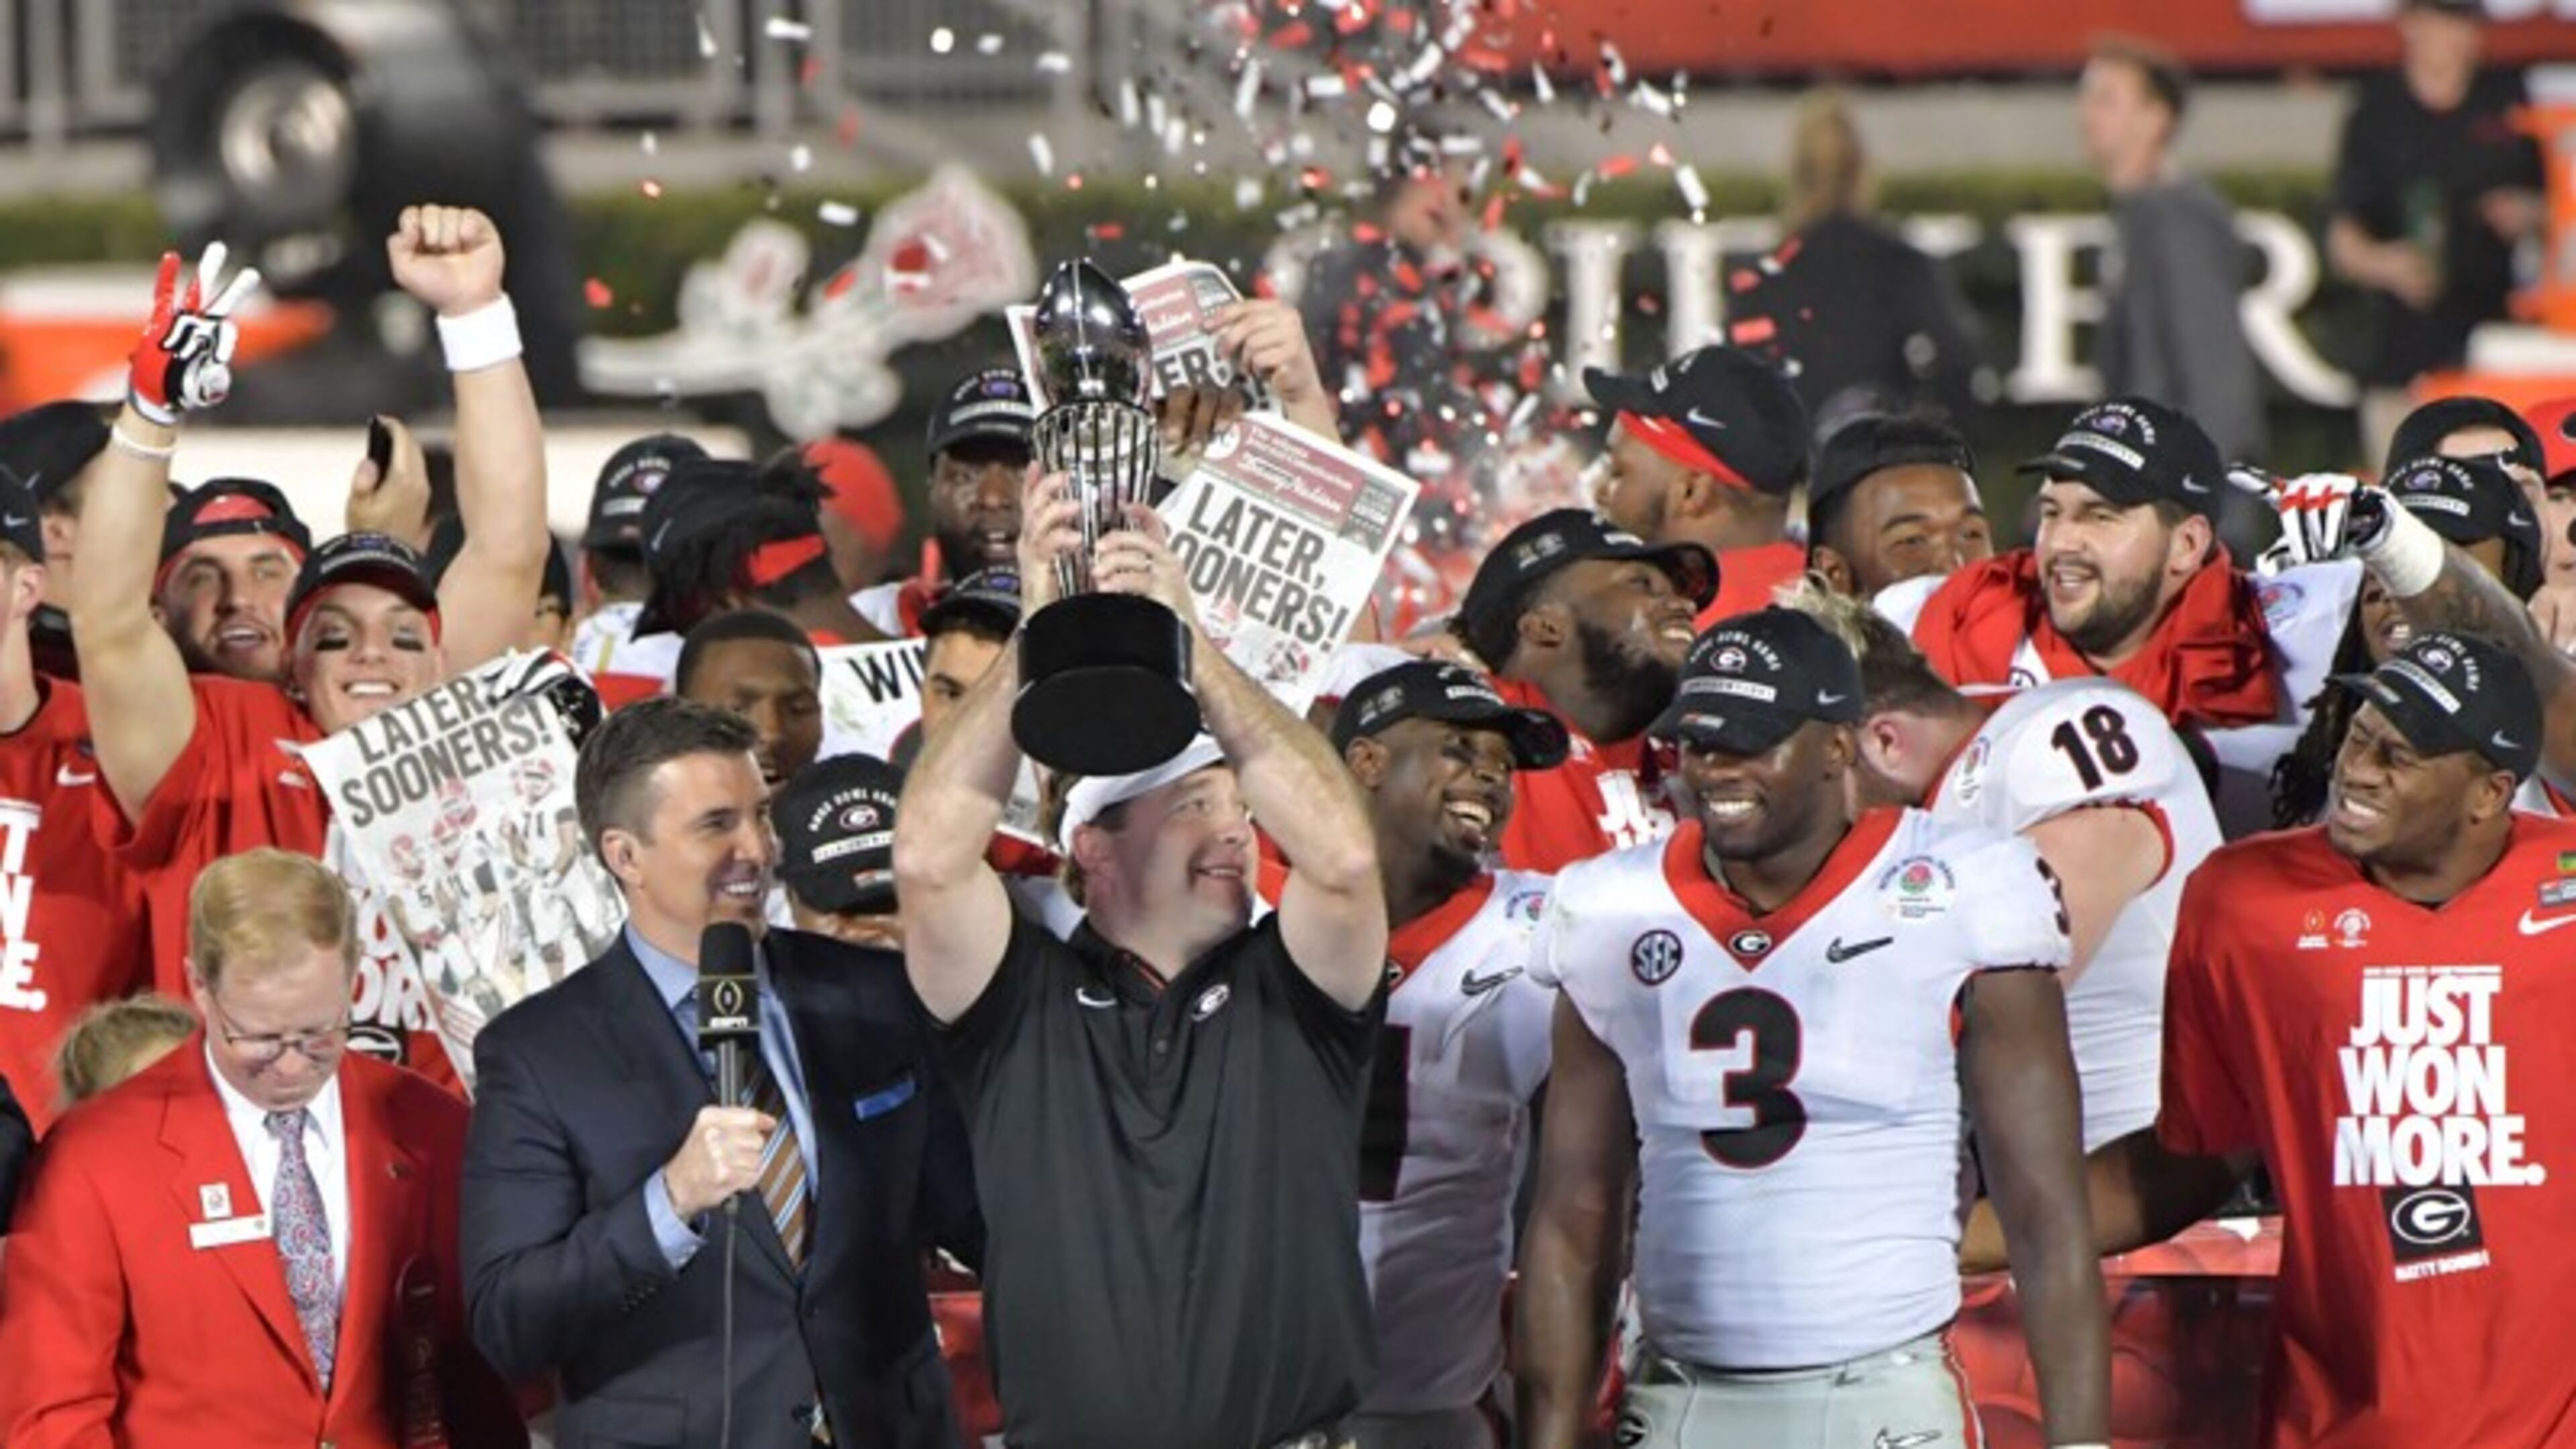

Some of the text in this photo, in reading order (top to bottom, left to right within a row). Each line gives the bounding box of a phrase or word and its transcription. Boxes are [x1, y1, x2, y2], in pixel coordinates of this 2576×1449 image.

[1189, 482, 1327, 590] LATER,
[1171, 533, 1349, 652] OONERS!
[341, 696, 553, 828] SOONERS!
[2051, 704, 2139, 793] 18
[1634, 933, 1681, 981] SEC
[2350, 975, 2502, 1047] JUST
[1689, 986, 1807, 1169] 3
[2338, 1044, 2507, 1116] WON
[2333, 1114, 2547, 1187] MORE.
